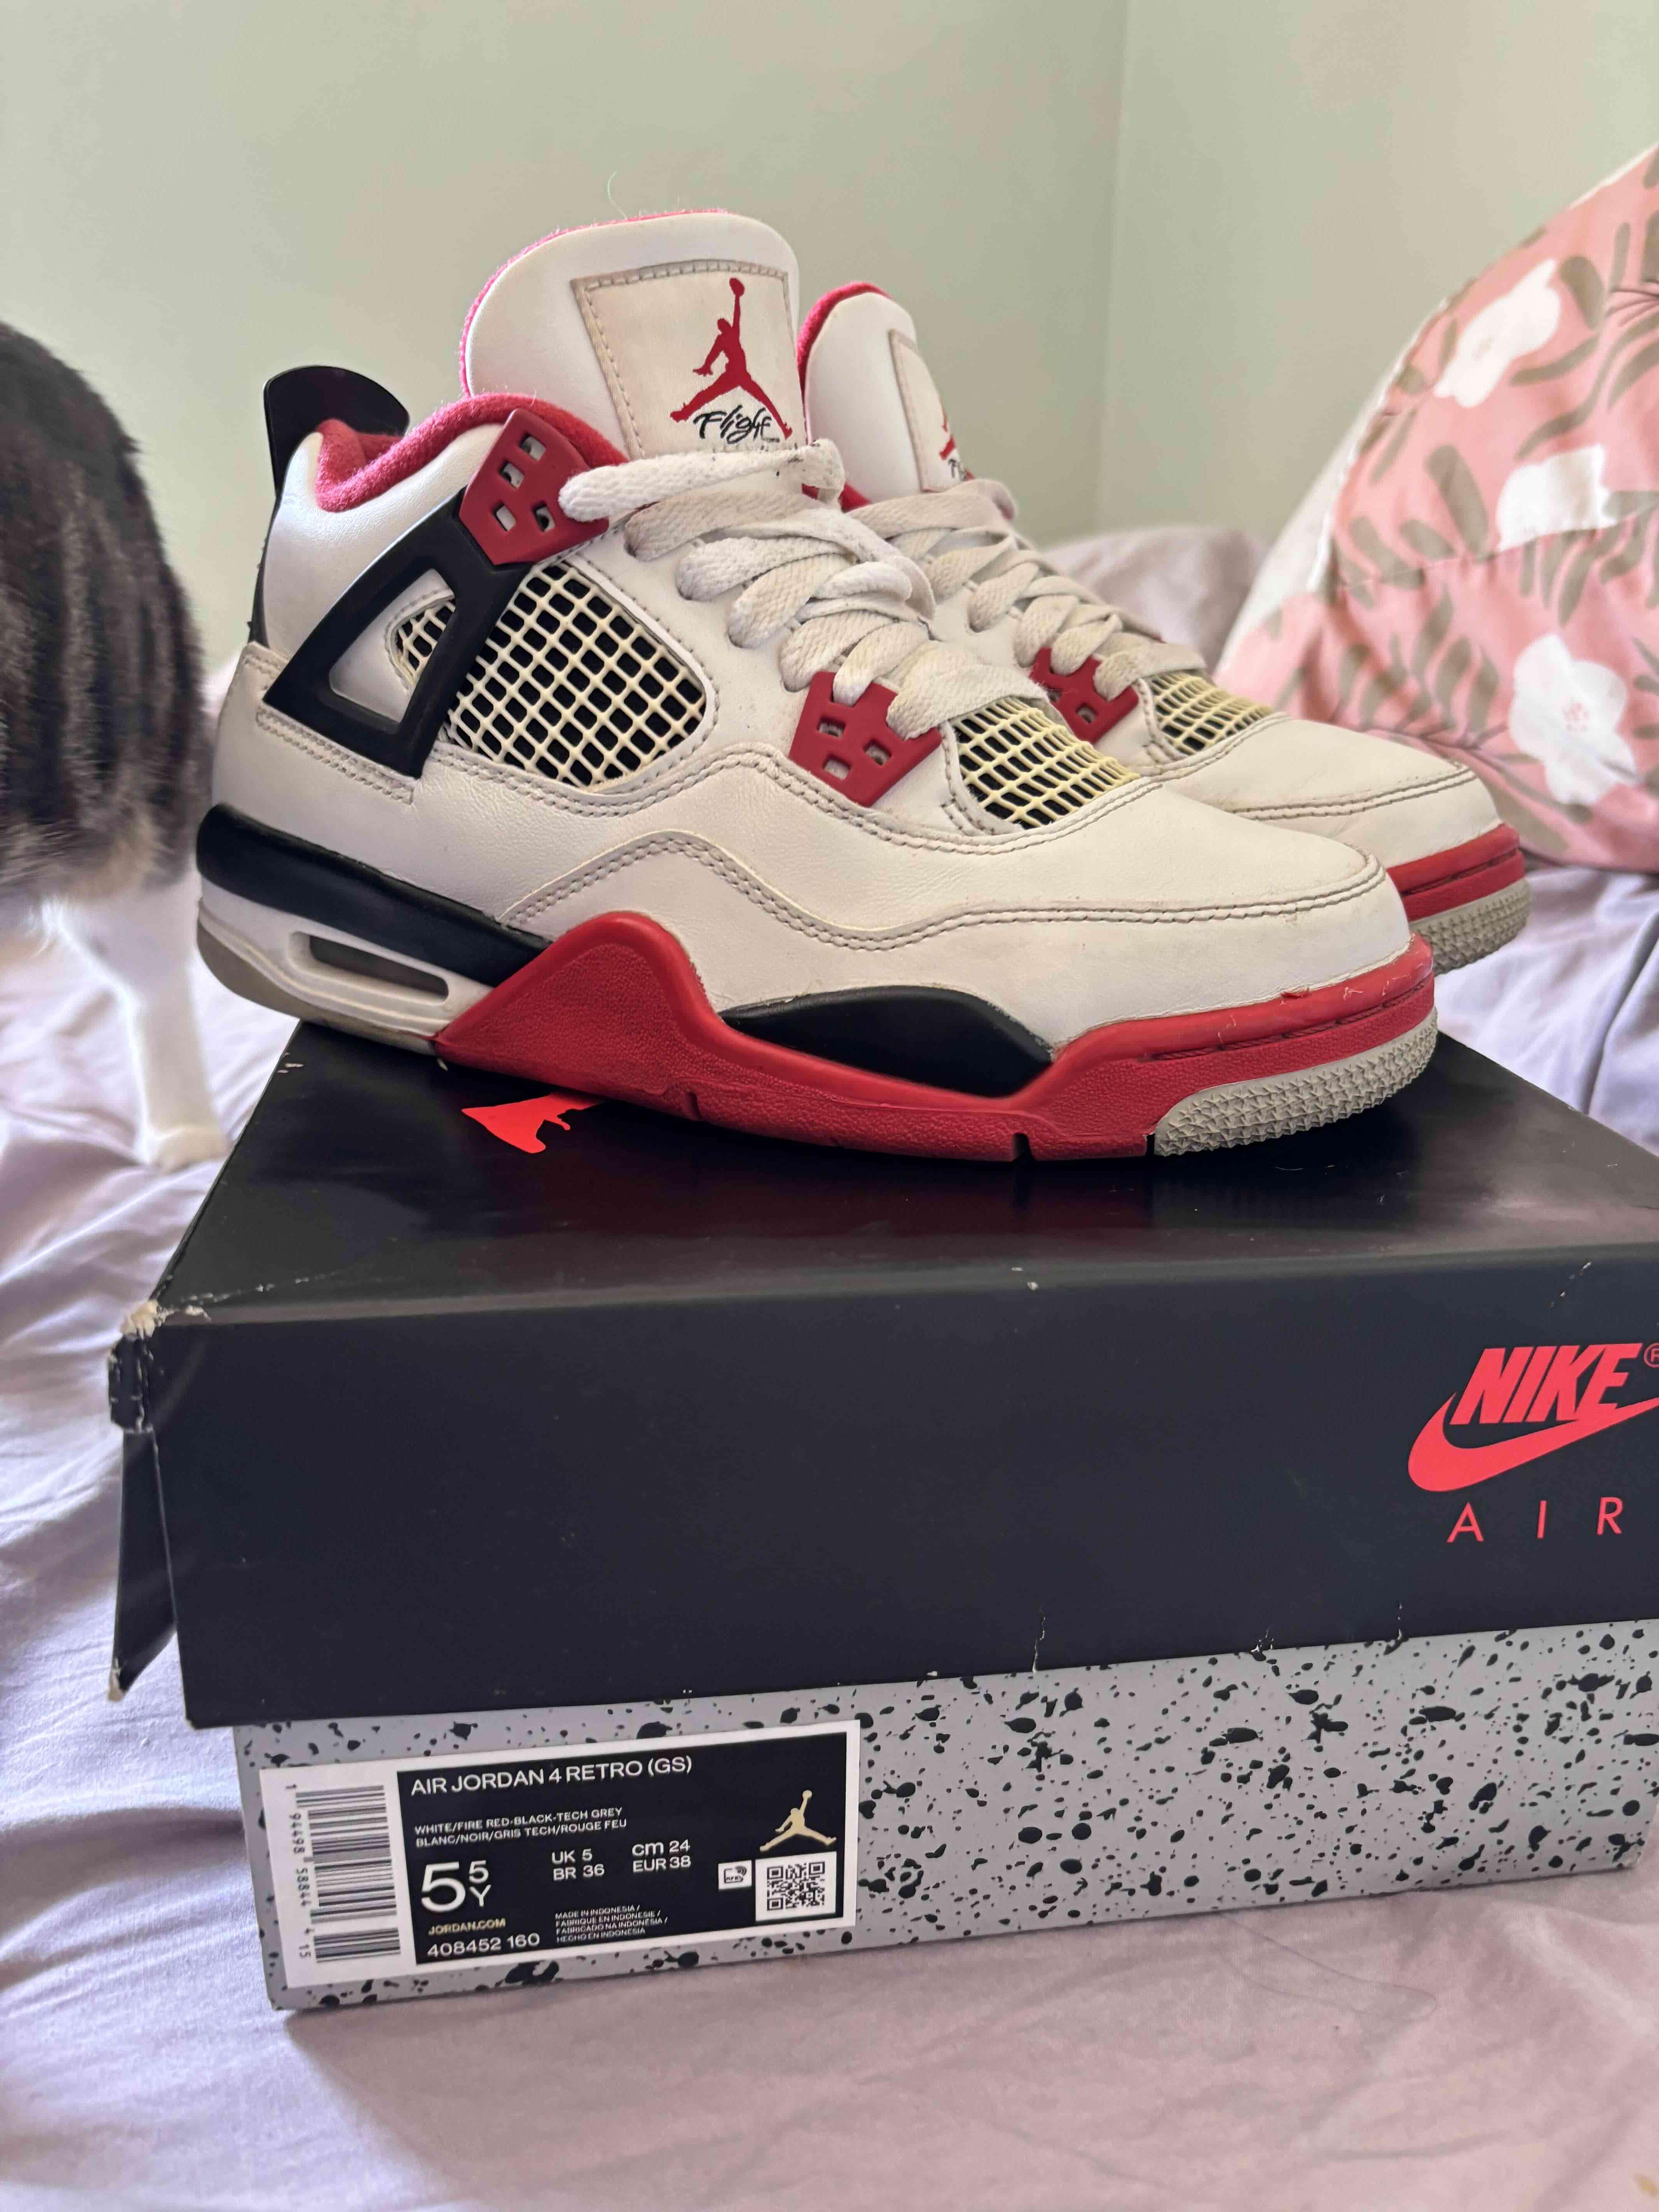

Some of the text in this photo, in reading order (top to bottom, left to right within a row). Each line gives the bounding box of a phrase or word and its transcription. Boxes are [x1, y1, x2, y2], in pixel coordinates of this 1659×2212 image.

[1449, 1343, 1643, 1425] NIKE
[1446, 1496, 1623, 1543] AIR
[411, 1755, 692, 1796] AIR JORDAN 4 RETRO (GS)
[414, 1820, 483, 1836] WHITE/FIRE
[591, 1807, 623, 1819] GREY
[416, 1819, 627, 1848] BLANC/NOIR/GRIS TECH/ROUGE FEU
[551, 1848, 593, 1865] UK 5
[632, 1839, 690, 1856] cm 24
[553, 1863, 605, 1881] BR 36
[633, 1855, 691, 1874] EUR 38
[421, 1860, 489, 1913] 5 5
[469, 1884, 492, 1907] Y
[555, 1911, 579, 1919] MADE
[591, 1905, 635, 1916] INDONESIA
[428, 1918, 506, 1936] JORDAN.COM
[556, 1917, 597, 1927] FABRIQUE
[556, 1923, 604, 1935] FABRICADO
[618, 1917, 663, 1928] INDONESIA
[556, 1933, 587, 1943] HECHO
[601, 1927, 646, 1938] INDONESIA
[427, 1933, 540, 1958] 408452 160
